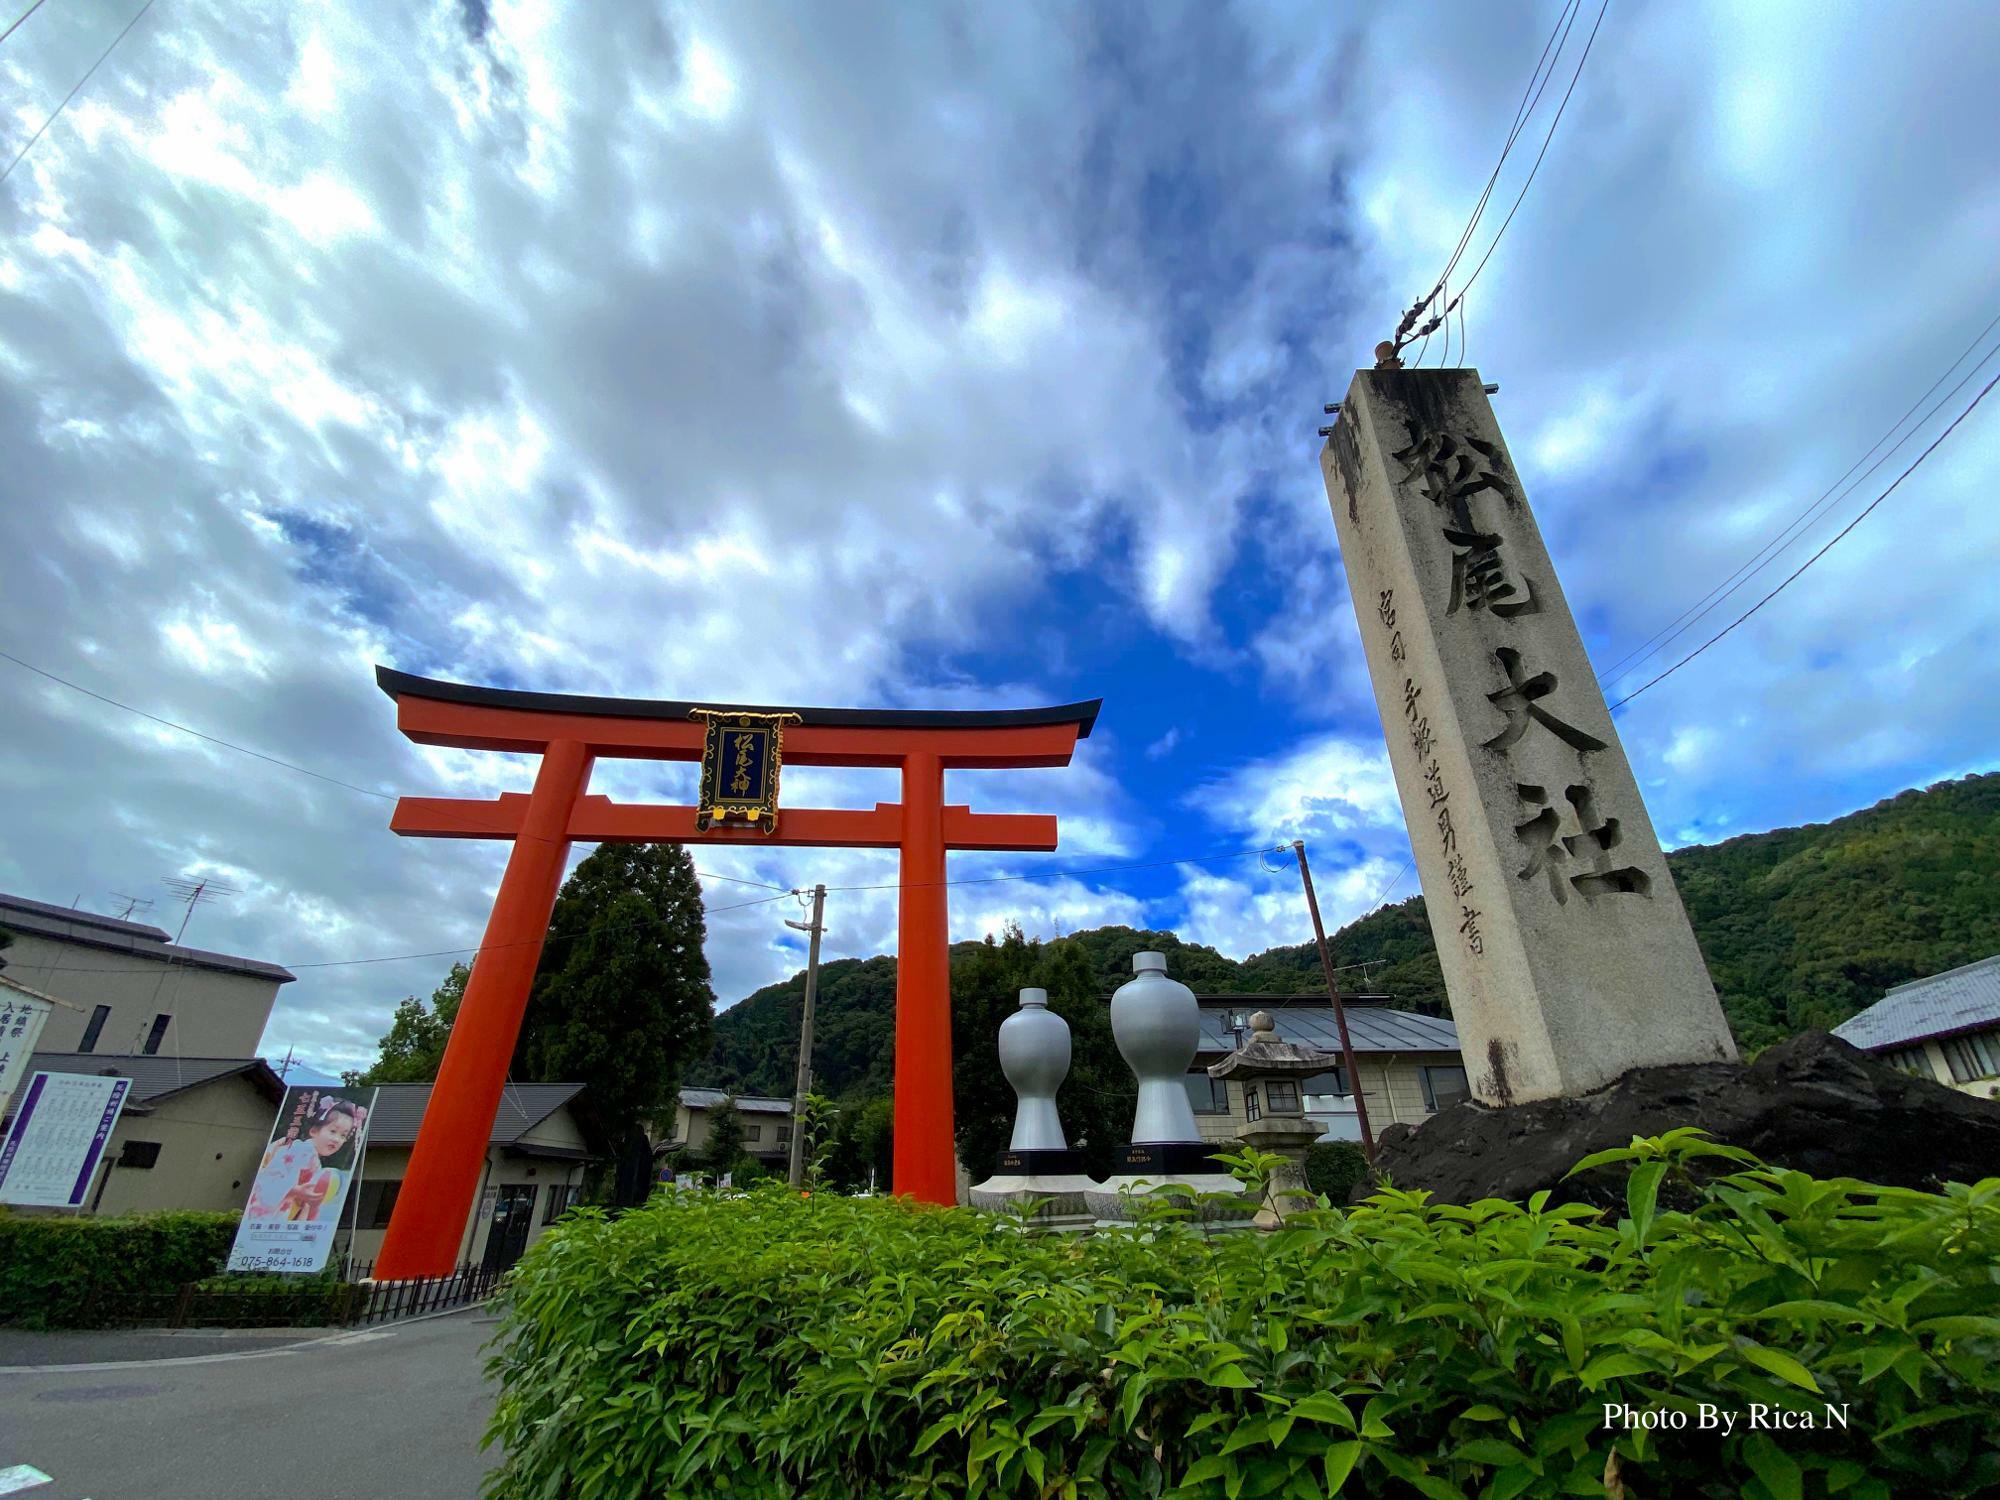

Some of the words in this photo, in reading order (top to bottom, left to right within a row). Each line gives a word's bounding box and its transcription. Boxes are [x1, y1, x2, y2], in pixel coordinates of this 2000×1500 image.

[1392, 419, 1654, 908] 松尾大社
[241, 1256, 313, 1267] 075-864-1618
